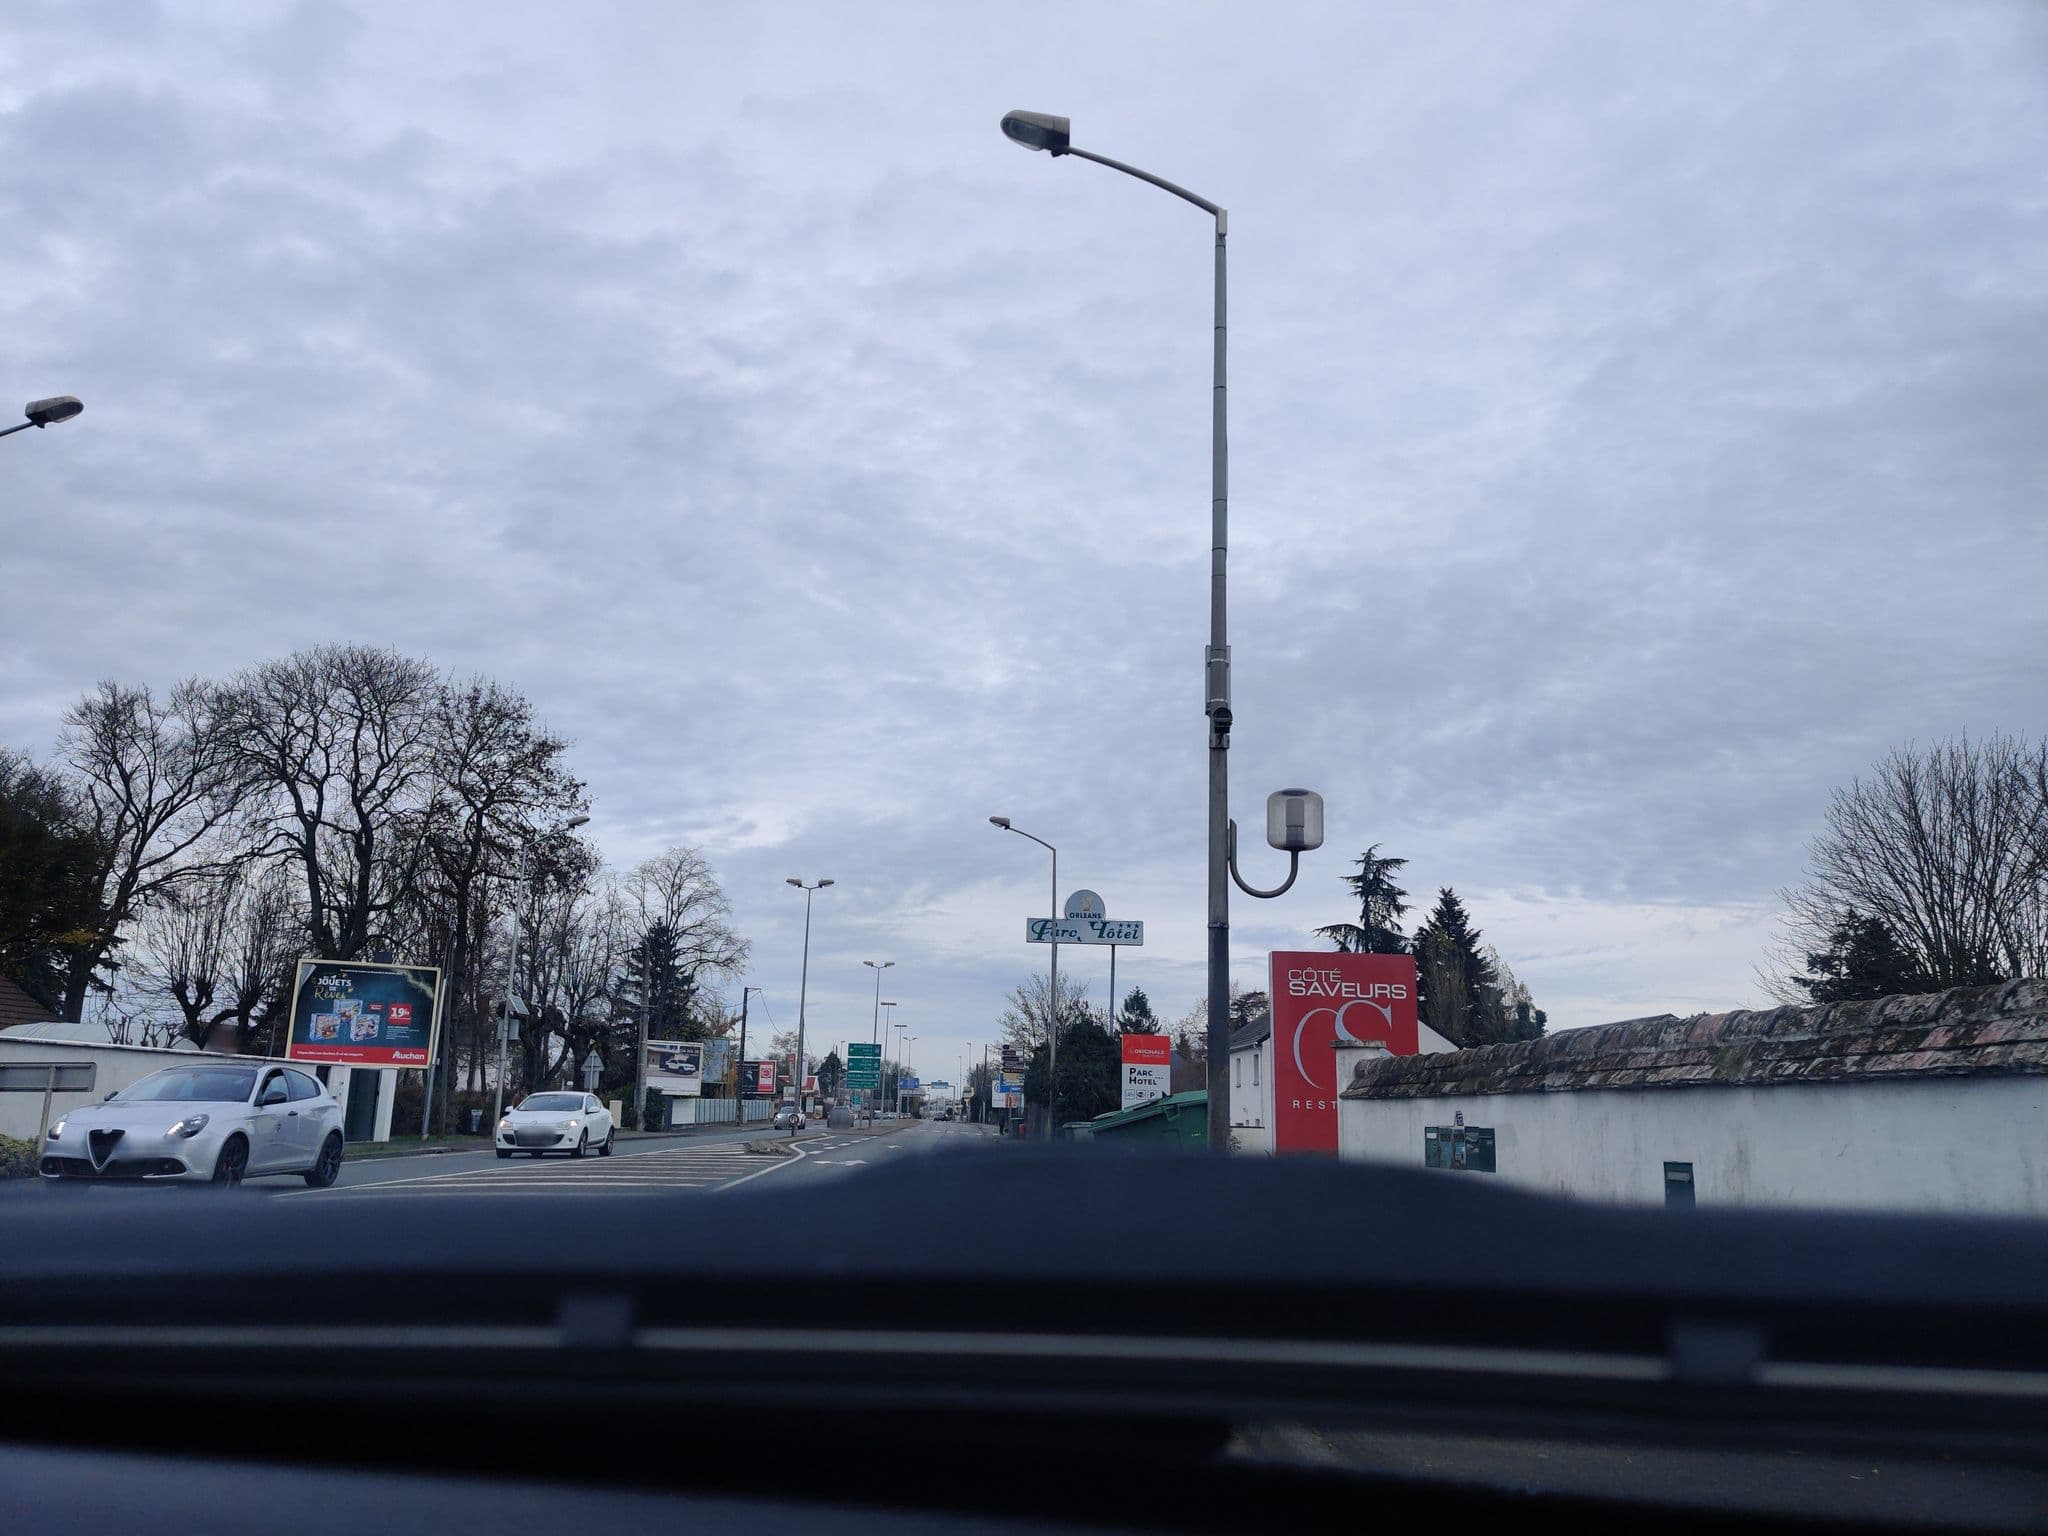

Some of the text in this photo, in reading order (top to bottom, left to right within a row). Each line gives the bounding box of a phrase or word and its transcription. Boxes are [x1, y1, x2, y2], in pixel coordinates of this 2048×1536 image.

[1288, 967, 1341, 982] CÔTÉ
[1289, 982, 1407, 999] SAVEURS
[392, 1050, 425, 1060] Auchan
[1292, 1100, 1337, 1110] REST
